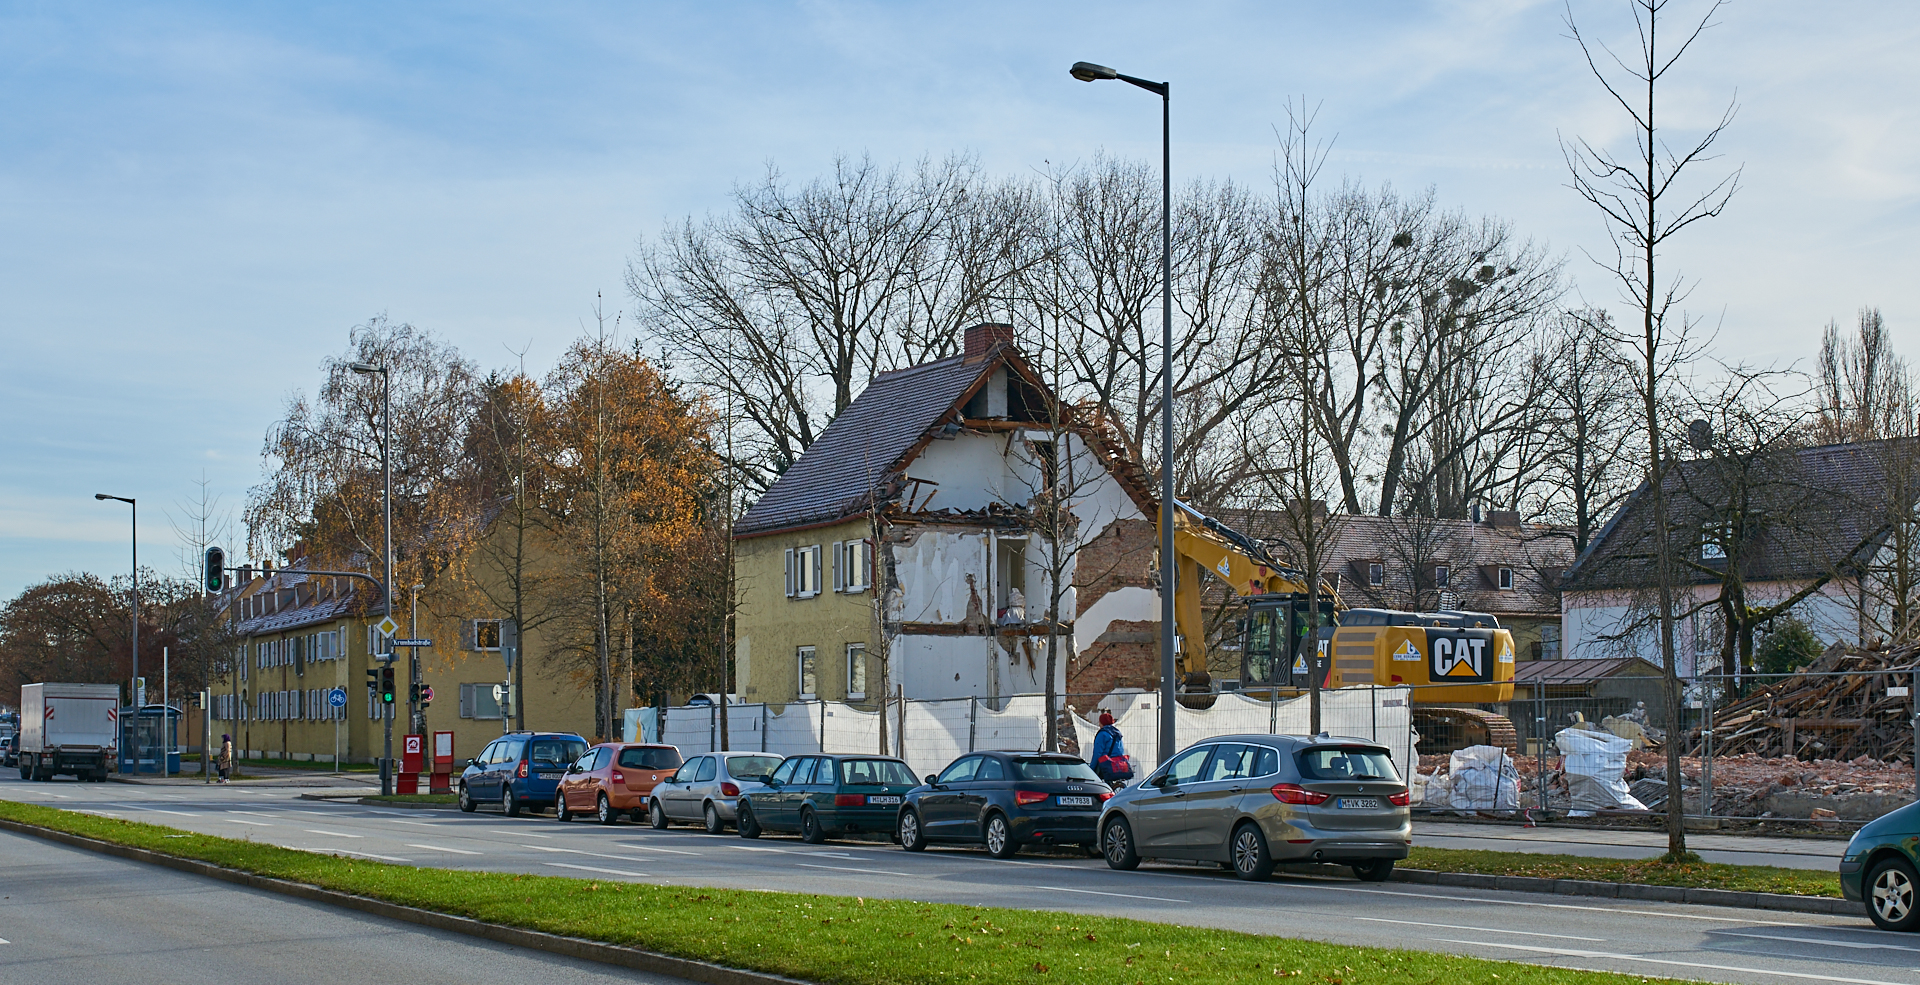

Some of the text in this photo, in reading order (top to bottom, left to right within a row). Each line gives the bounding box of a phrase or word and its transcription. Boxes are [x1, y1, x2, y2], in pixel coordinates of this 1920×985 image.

[1317, 639, 1329, 658] AT
[1434, 638, 1486, 676] CAT
[1342, 799, 1377, 808] M VK 3282
